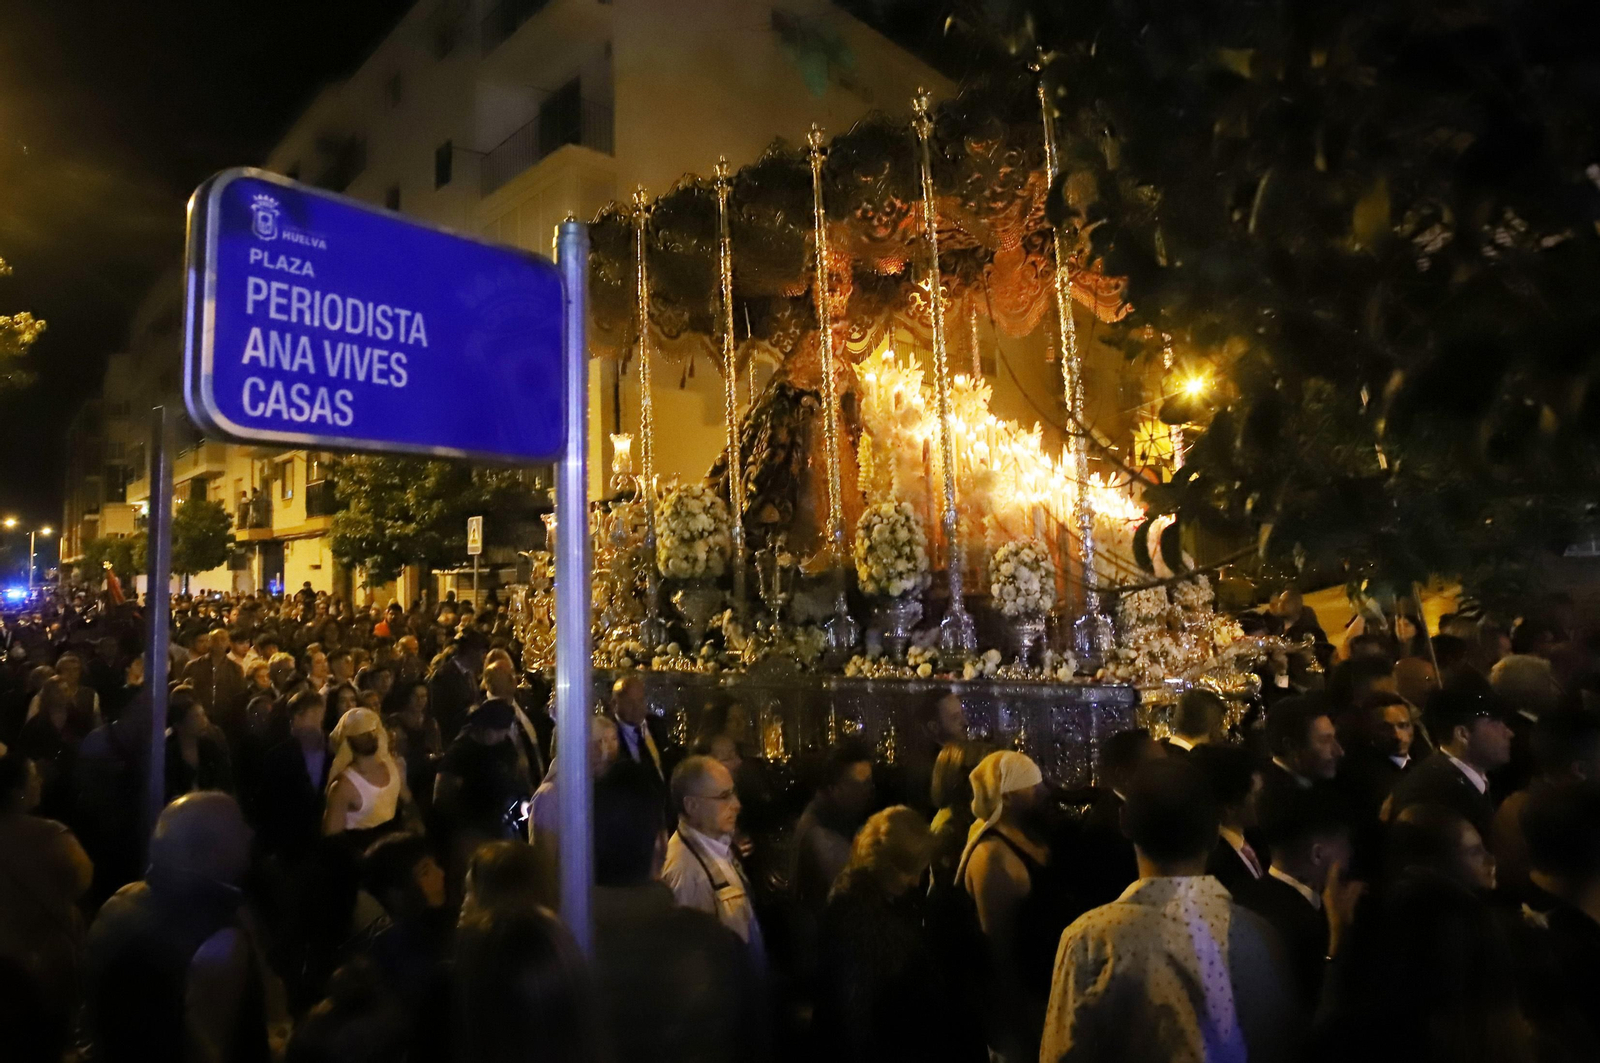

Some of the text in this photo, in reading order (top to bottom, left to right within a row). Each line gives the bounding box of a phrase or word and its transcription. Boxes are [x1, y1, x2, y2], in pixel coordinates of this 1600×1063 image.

[249, 248, 315, 278] PLAZA
[282, 230, 327, 250] HUELVA
[246, 276, 428, 347] PERIODISTA
[242, 327, 409, 388] ANA VIVES
[242, 376, 354, 427] CASAS
